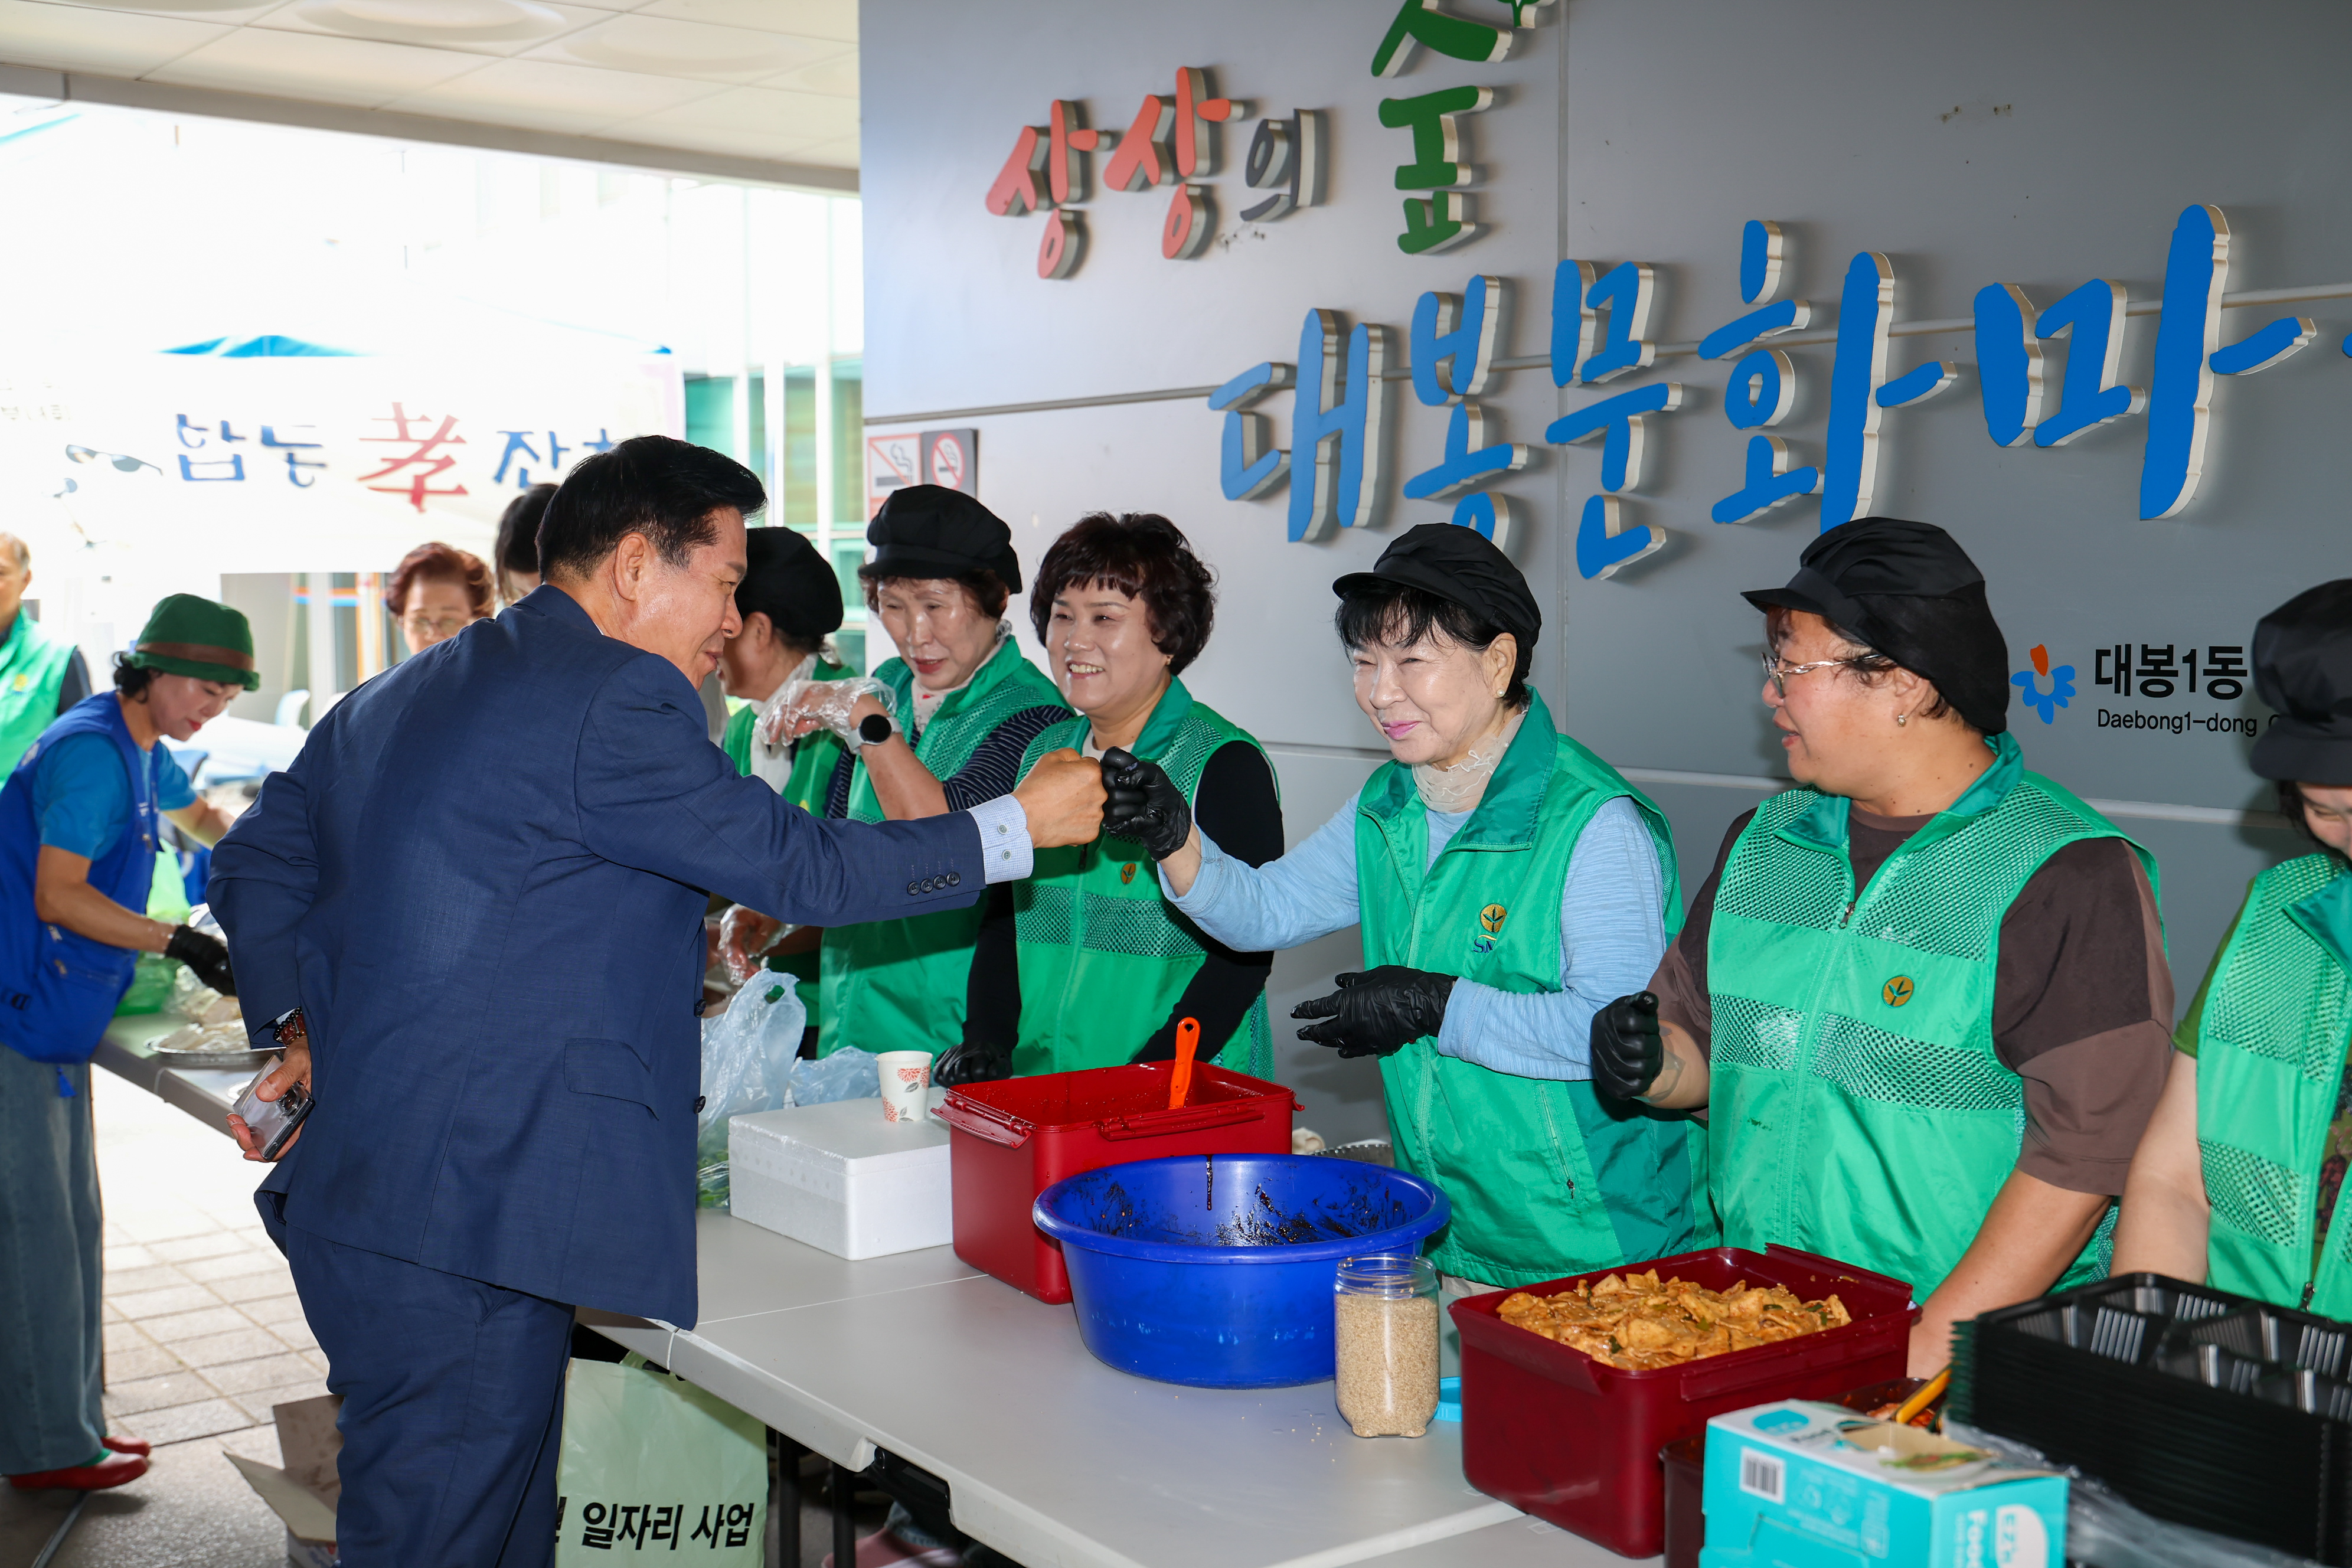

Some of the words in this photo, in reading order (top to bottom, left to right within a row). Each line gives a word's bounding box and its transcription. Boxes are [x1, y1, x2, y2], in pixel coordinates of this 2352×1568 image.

[986, 66, 1329, 279] 상상의
[1371, 0, 1514, 255] 숲
[1208, 204, 2352, 582] 대봉문화마
[2095, 643, 2248, 700] 대봉1동
[2097, 708, 2258, 737] Daebong1-dong
[582, 1502, 684, 1550] 일자리
[690, 1502, 754, 1549] 사업
